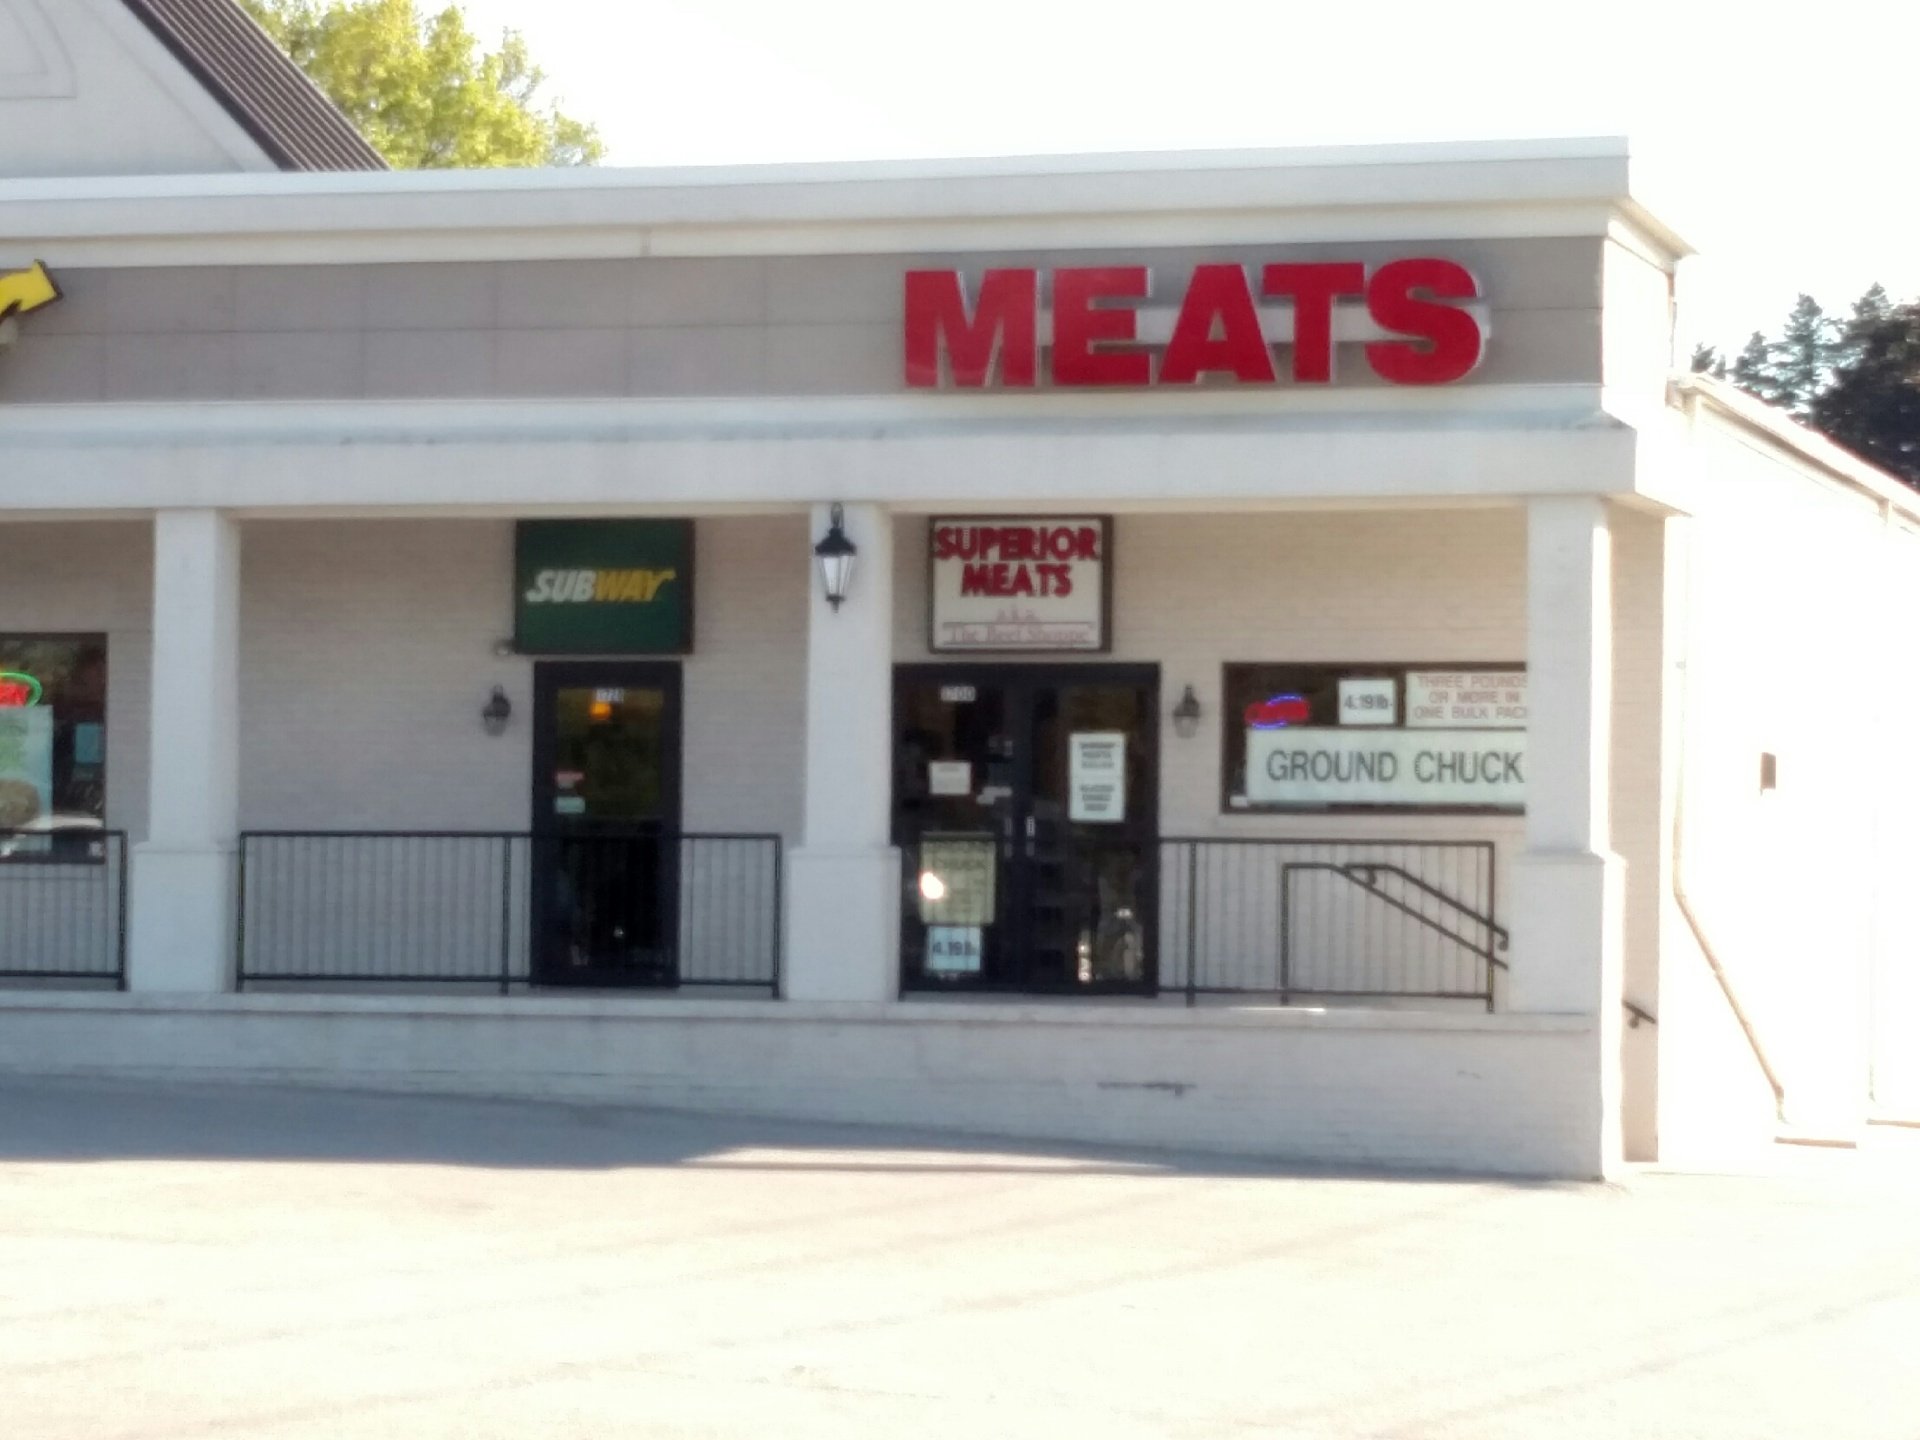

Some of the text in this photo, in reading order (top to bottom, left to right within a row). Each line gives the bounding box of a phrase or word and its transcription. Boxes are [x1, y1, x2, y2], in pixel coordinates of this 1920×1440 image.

[904, 257, 1483, 388] MEATS
[934, 526, 1101, 561] SUPERIOR
[525, 568, 678, 603] SUBWAY
[961, 563, 1074, 597] MEATS
[1417, 674, 1464, 688] THREE
[1428, 690, 1519, 704] OR MORE IN
[1414, 705, 1528, 719] ONE BULK PAC
[1267, 749, 1525, 783] GROUND CHUCK
